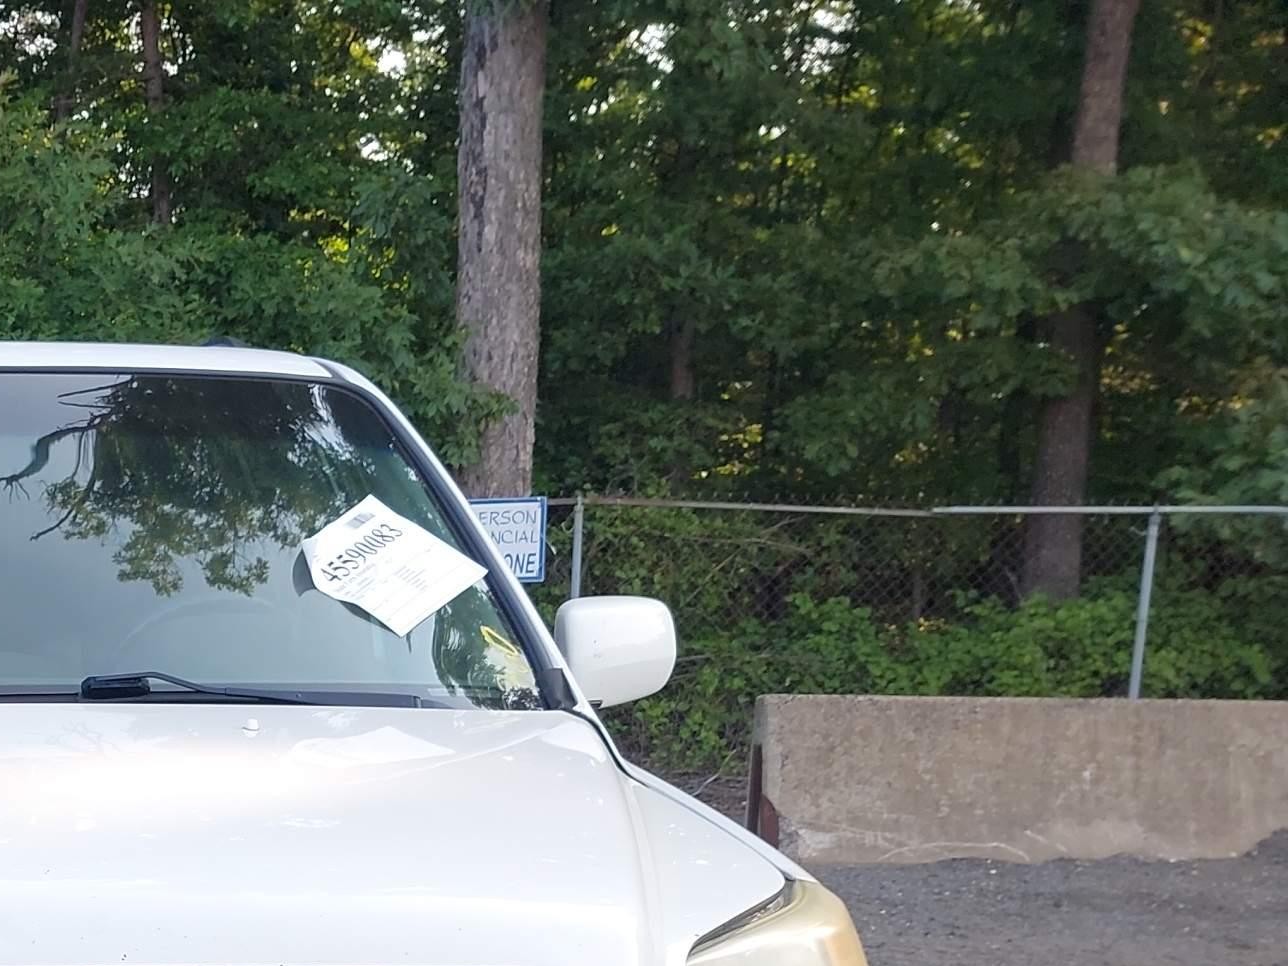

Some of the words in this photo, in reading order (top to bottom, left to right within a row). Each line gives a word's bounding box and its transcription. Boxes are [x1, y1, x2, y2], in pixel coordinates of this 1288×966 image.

[478, 510, 537, 526] ERSON
[490, 529, 539, 545] NCIAL
[320, 523, 404, 583] 45590083
[503, 552, 537, 574] ONE
